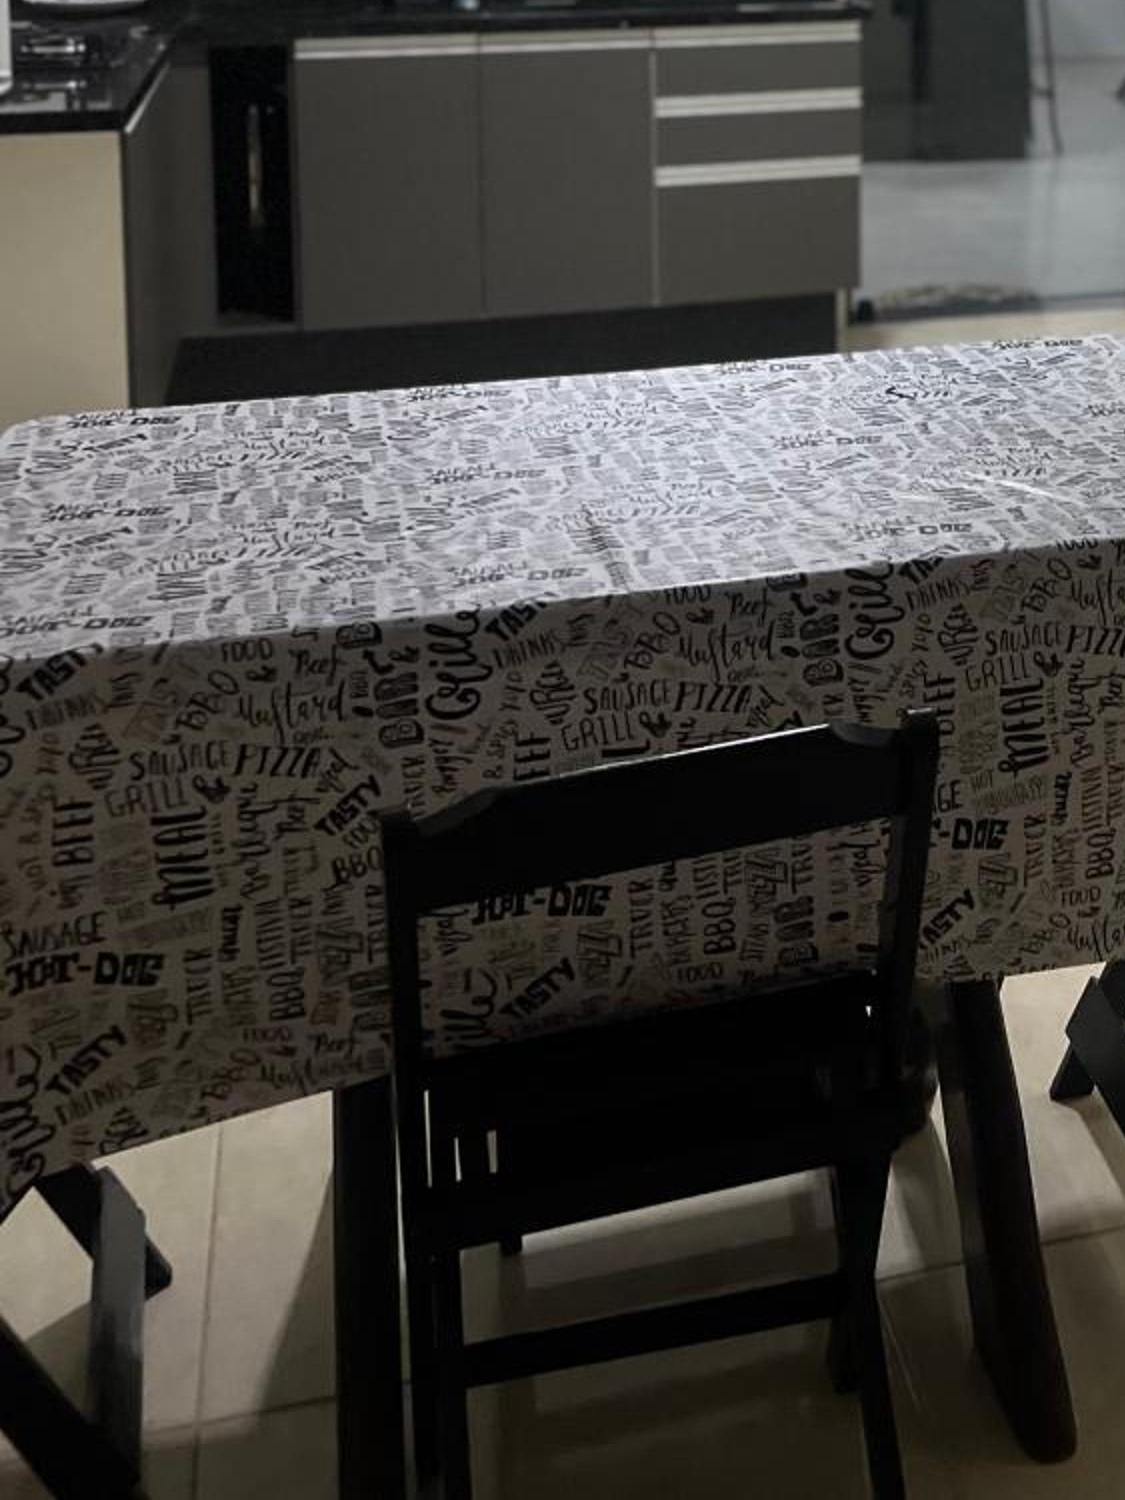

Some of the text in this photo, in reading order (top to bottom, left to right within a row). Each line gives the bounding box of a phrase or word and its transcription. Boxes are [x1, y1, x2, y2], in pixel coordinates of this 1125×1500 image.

[673, 681, 752, 713] PIZZA
[561, 710, 637, 751] GRILL
[998, 677, 1050, 779] MEAL
[233, 743, 324, 779] PIZZA
[513, 732, 551, 781] EEF
[51, 799, 95, 868] BEEF
[149, 804, 216, 911] MEAL
[702, 900, 737, 955] BBQ
[920, 888, 975, 949] ASTY
[4, 951, 165, 998] HOT-DOG
[266, 968, 306, 1022] BBQ
[45, 1024, 128, 1096] TASTY
